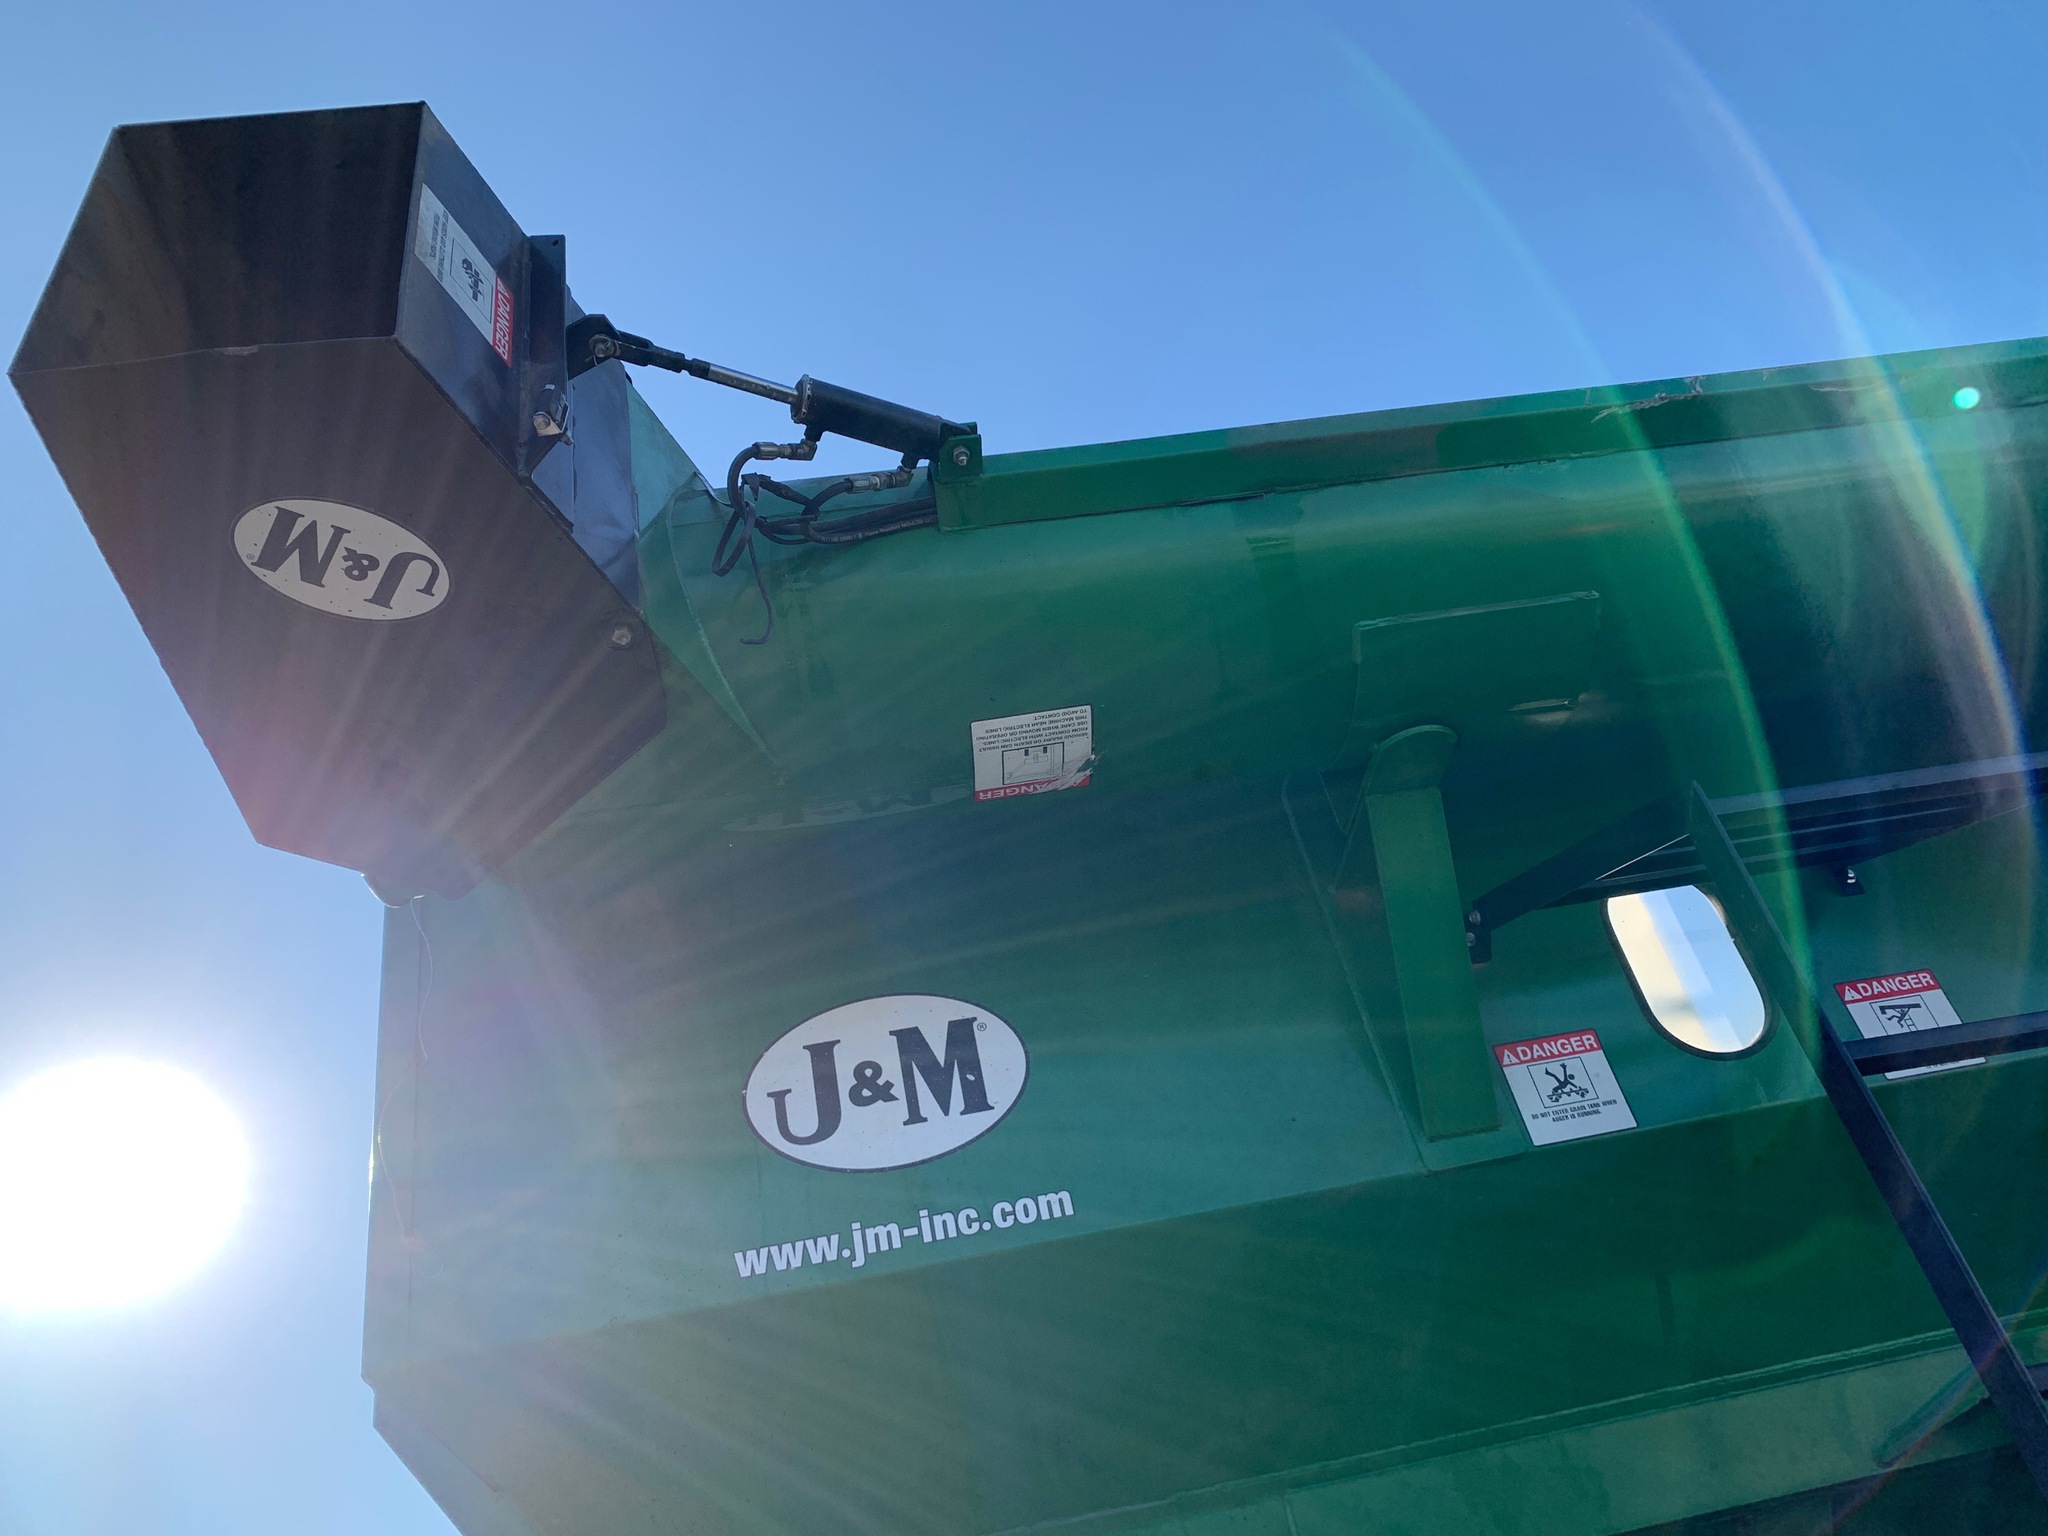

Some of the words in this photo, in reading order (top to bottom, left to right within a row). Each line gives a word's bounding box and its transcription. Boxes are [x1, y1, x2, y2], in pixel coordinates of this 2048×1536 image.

[495, 293, 510, 361] DANGER
[251, 506, 440, 610] J&M
[976, 733, 1007, 741] OPERATING
[1001, 735, 1027, 743] ELECTRIC
[979, 782, 1058, 800] ANGER
[1857, 973, 1935, 997] DANGER
[1516, 1034, 1599, 1061] DANGER
[767, 1016, 995, 1146] J&M
[1552, 1108, 1569, 1116] ENTER
[733, 1189, 1075, 1278] www.jm-inc.com
